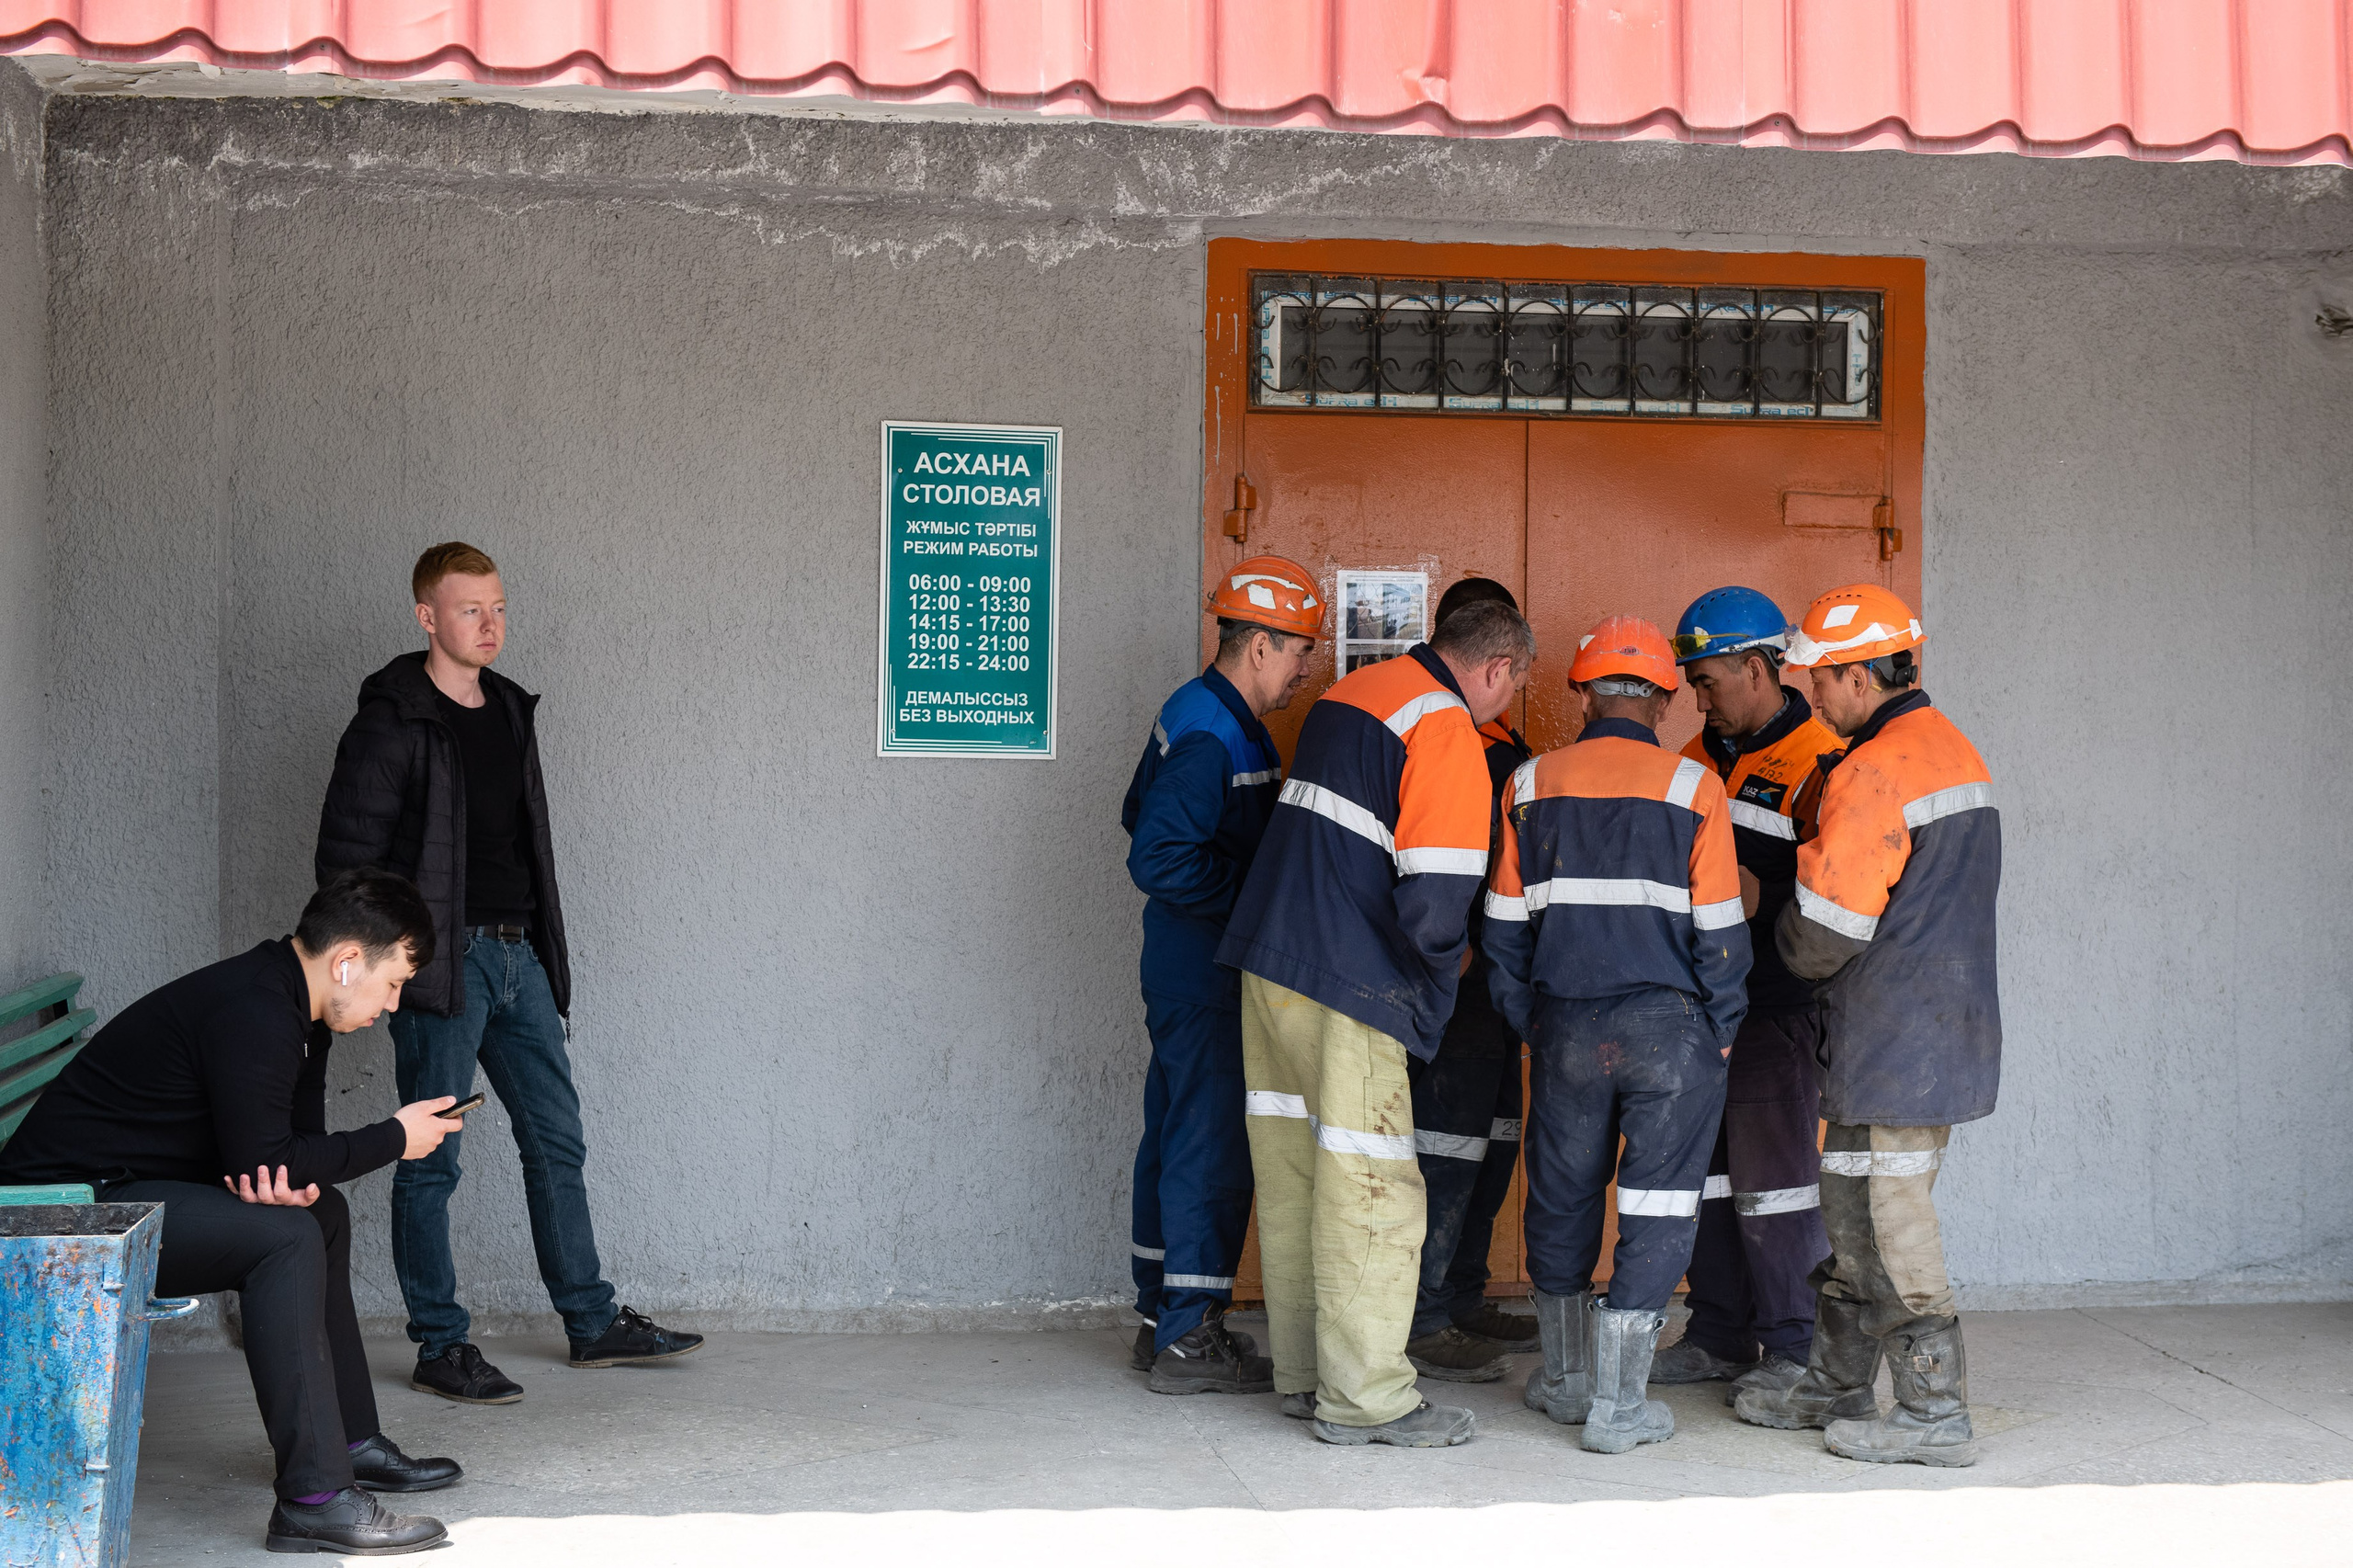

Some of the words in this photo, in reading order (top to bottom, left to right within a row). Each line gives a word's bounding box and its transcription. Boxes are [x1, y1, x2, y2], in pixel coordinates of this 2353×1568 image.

[913, 451, 1031, 477] АСХАНА
[903, 483, 1040, 507] СТОЛОВАЯ
[905, 520, 971, 535] ЖҰМЫС
[974, 522, 1037, 538] ТӘРТІБІ
[904, 540, 964, 555] РЕЖИМ
[968, 542, 1038, 557] РАБОТЫ
[908, 574, 961, 591] 06:00
[979, 575, 1031, 594] 09:00
[908, 594, 961, 611] 12:00
[979, 596, 1030, 613] 13:30
[908, 613, 961, 631] 14:15
[979, 615, 1030, 632] 17:00
[908, 633, 960, 651] 19:00
[977, 635, 1029, 652] 21:00
[907, 653, 961, 670] 22:15
[977, 654, 1029, 672] 24:00
[904, 690, 1029, 707] ДЕМАЛЫССЫЗ
[899, 709, 931, 722] БЕЗ
[936, 710, 1035, 725] ВЫХОДНЫХ
[1743, 785, 1759, 796] KAZ
